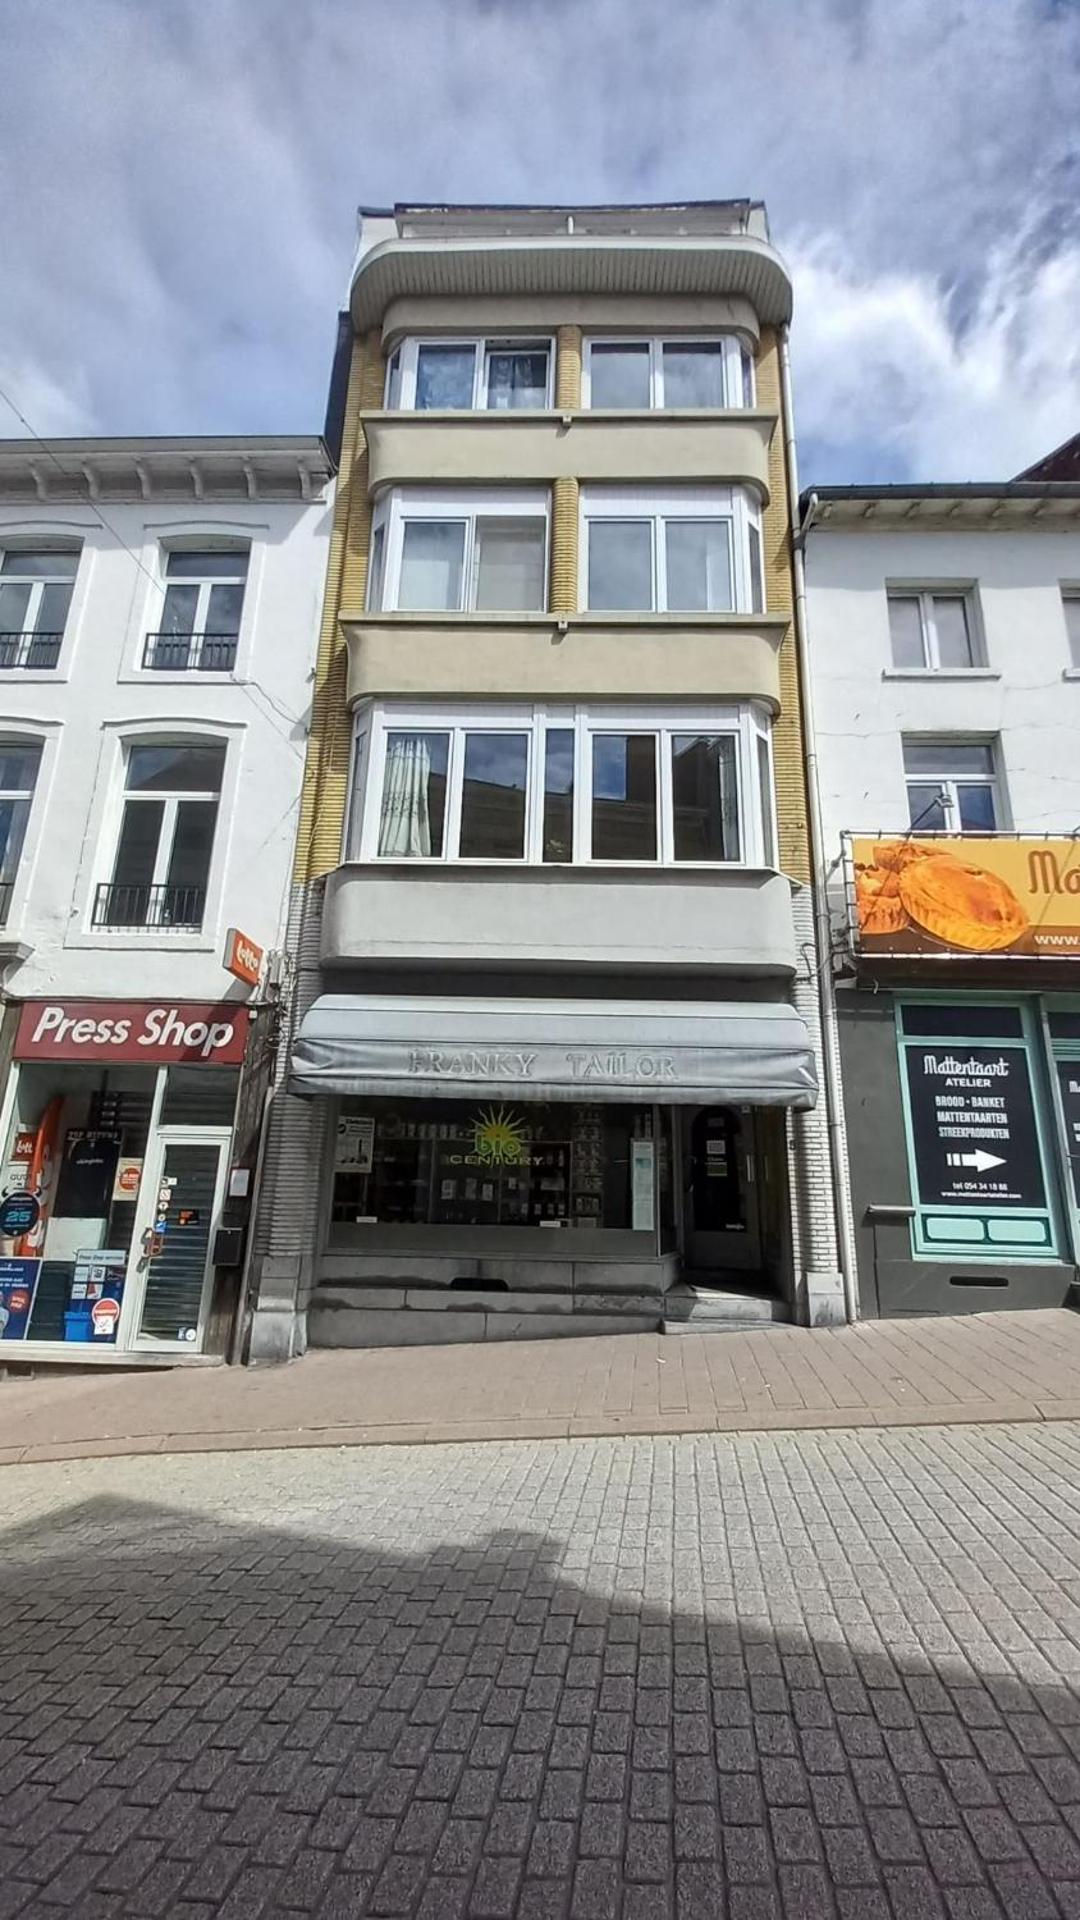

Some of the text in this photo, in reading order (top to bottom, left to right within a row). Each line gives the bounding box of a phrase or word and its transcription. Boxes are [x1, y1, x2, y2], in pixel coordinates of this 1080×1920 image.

[236, 939, 259, 972] lotto
[31, 1006, 234, 1057] Press Shop
[408, 1050, 679, 1079] FRANKY TAILOR
[923, 1054, 1010, 1077] Mattentaart
[945, 1078, 992, 1088] ATELIER
[935, 1095, 1006, 1109] BROOD BANKET
[936, 1111, 1009, 1124] MATTENTAARTEN
[938, 1126, 1011, 1140] STREEKPRODUKTEN
[449, 1154, 544, 1166] CENTURY
